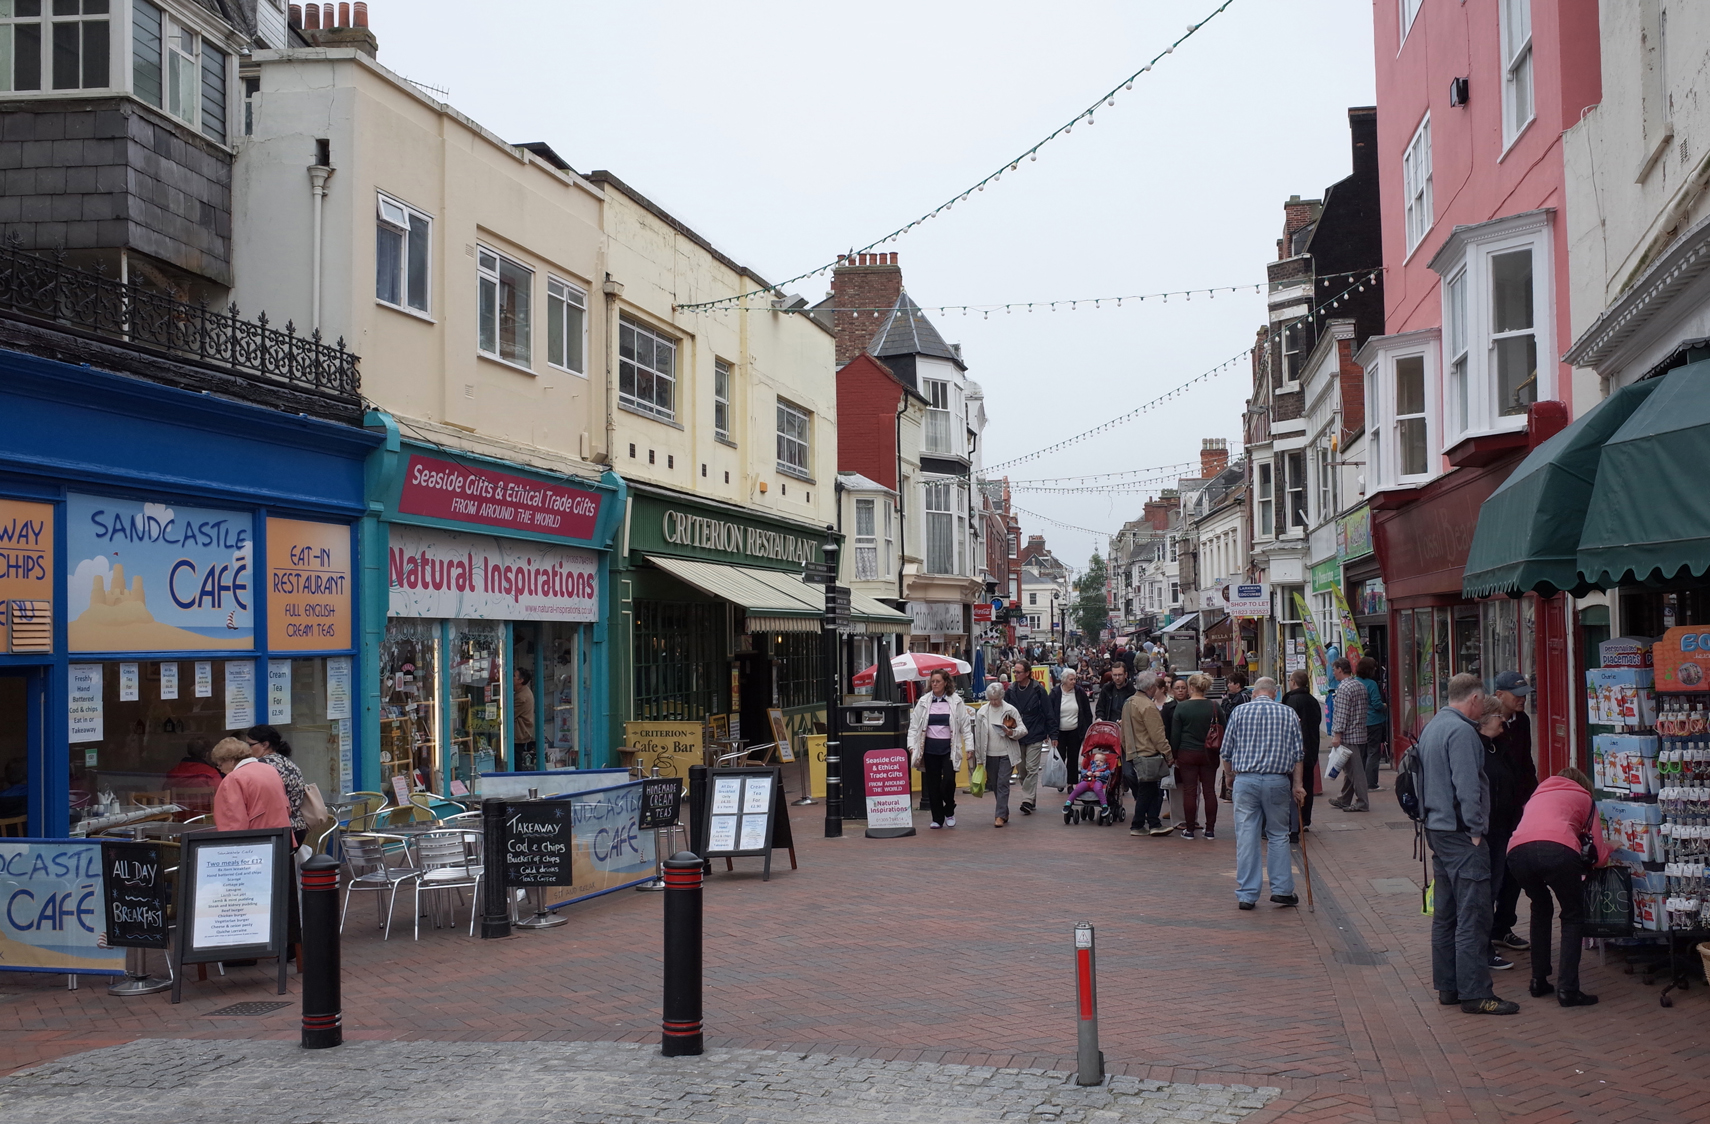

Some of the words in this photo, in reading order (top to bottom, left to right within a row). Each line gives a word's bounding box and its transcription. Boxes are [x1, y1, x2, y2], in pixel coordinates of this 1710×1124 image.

[412, 464, 463, 493] Seaside
[465, 475, 494, 499] Gifts
[495, 483, 504, 500] &
[506, 483, 542, 507] Ethical
[545, 491, 572, 512] Trade
[573, 497, 596, 517] Gifts
[451, 498, 476, 515] FROM
[479, 502, 515, 521] AROUND
[517, 508, 532, 523] THE
[534, 511, 561, 528] WORLD
[91, 509, 248, 550] SANDCASTLE
[663, 510, 744, 552] CRITERION
[745, 526, 817, 562] RESTAURANT
[290, 544, 331, 567] EAT-IN
[389, 546, 476, 593] Natural
[483, 555, 595, 604] Inspirations
[273, 572, 346, 595] RESTAURANT
[285, 603, 301, 617] FULL
[305, 603, 336, 618] ENGLISH
[524, 603, 593, 616] www.natural-inspirations.co.uk
[286, 623, 314, 637] CREAM
[317, 623, 335, 637] TEAS
[74, 675, 93, 683] Freshly
[85, 705, 98, 714] chips
[72, 726, 96, 734] Takeaway
[640, 730, 687, 738] CRITERION
[633, 740, 658, 753] Cafe
[673, 741, 694, 753] Bar
[646, 784, 677, 795] HOMEMADE
[650, 793, 673, 807] CREAM
[573, 789, 641, 826] NDCASTL
[656, 807, 672, 818] TEAS
[870, 806, 908, 814] Inspirations
[507, 814, 562, 835] TAKEAWAY
[508, 838, 529, 853] Cod
[0, 848, 101, 880] CASTL
[534, 856, 540, 864] of
[113, 860, 131, 879] ALL
[132, 861, 157, 887] DAY
[520, 866, 536, 874] Cold
[565, 886, 578, 896] AND
[113, 902, 163, 929] BREAKFAST
